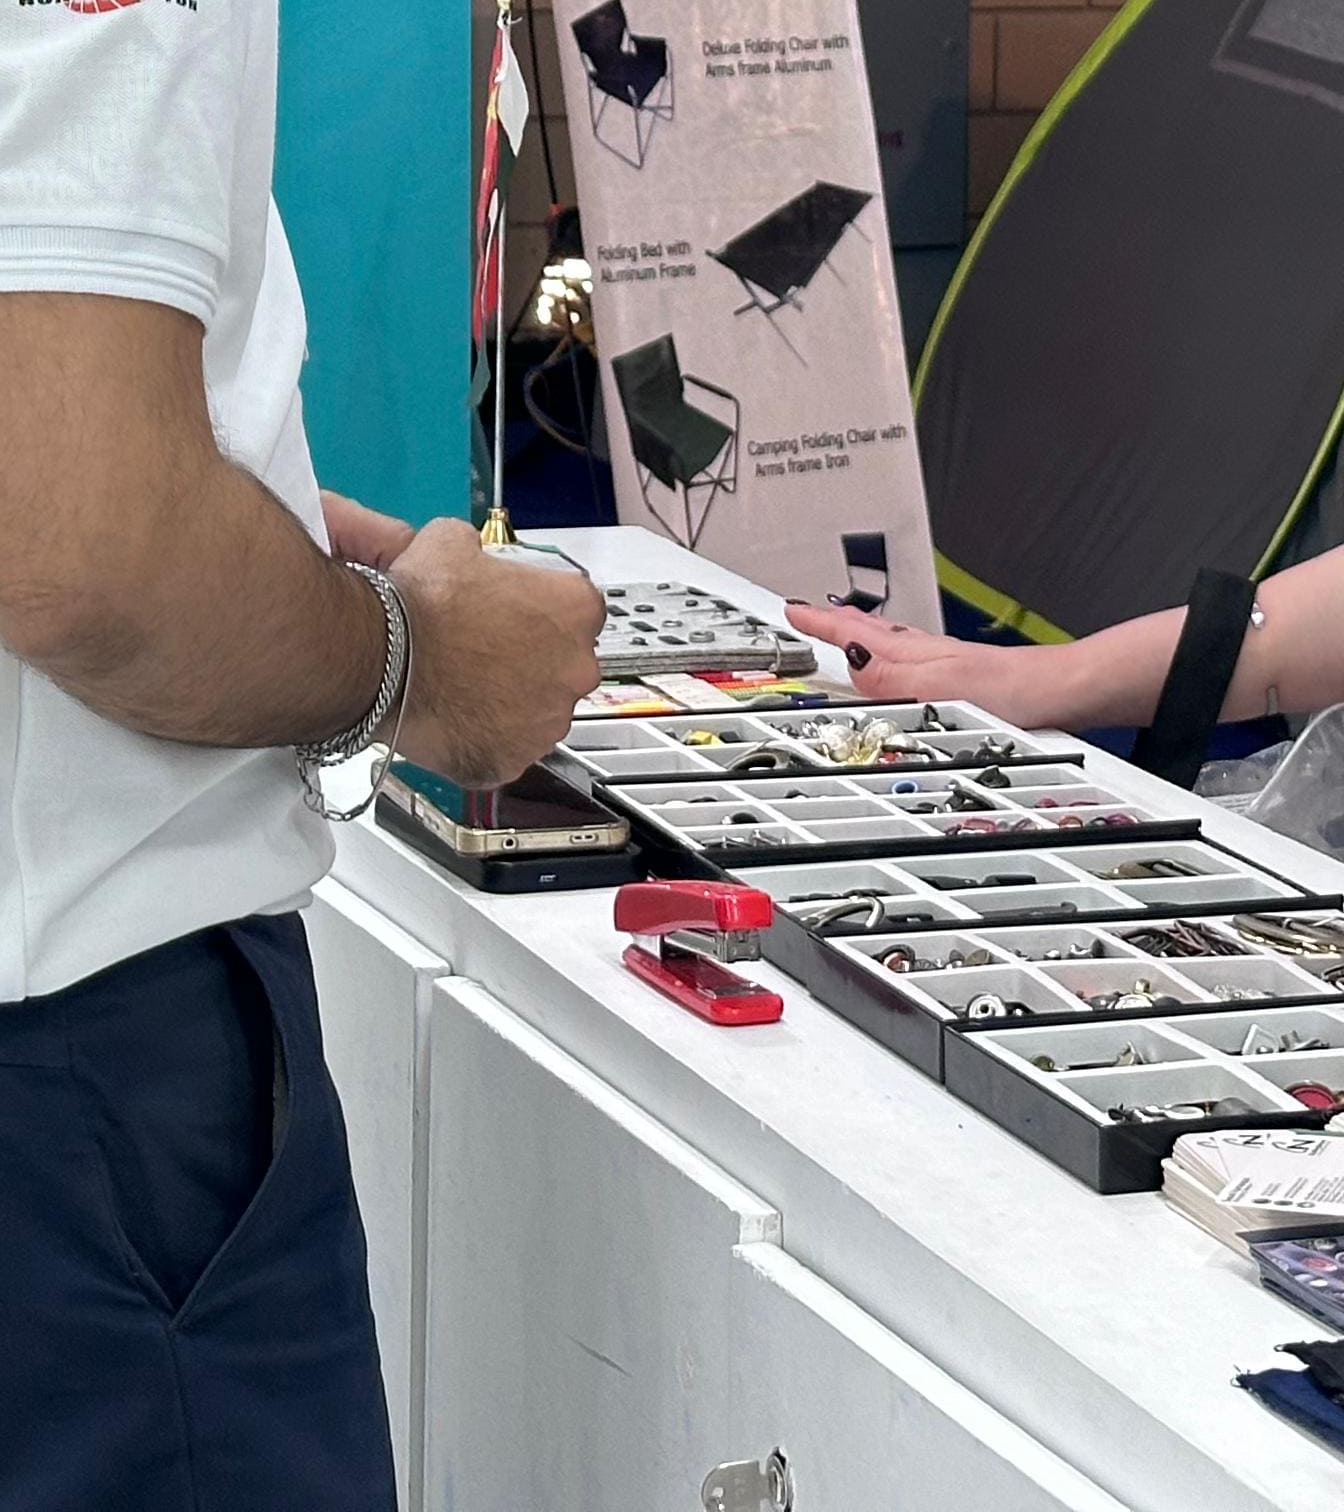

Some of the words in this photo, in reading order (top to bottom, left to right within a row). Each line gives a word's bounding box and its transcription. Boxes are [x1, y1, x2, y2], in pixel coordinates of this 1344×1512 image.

[744, 37, 786, 55] Folding
[788, 34, 819, 51] Chair
[822, 34, 850, 49] with
[706, 63, 735, 78] Arms
[774, 58, 833, 76] Aluminum
[596, 244, 638, 263] Folding
[640, 241, 663, 258] Bed
[665, 239, 692, 257] with
[659, 261, 697, 279] Frame
[746, 438, 799, 456] Camping
[800, 431, 844, 450] Folding
[846, 428, 877, 444] Chair
[880, 422, 906, 440] with
[755, 462, 786, 478] Arms
[788, 457, 822, 473] frame
[824, 453, 850, 469] Iron
